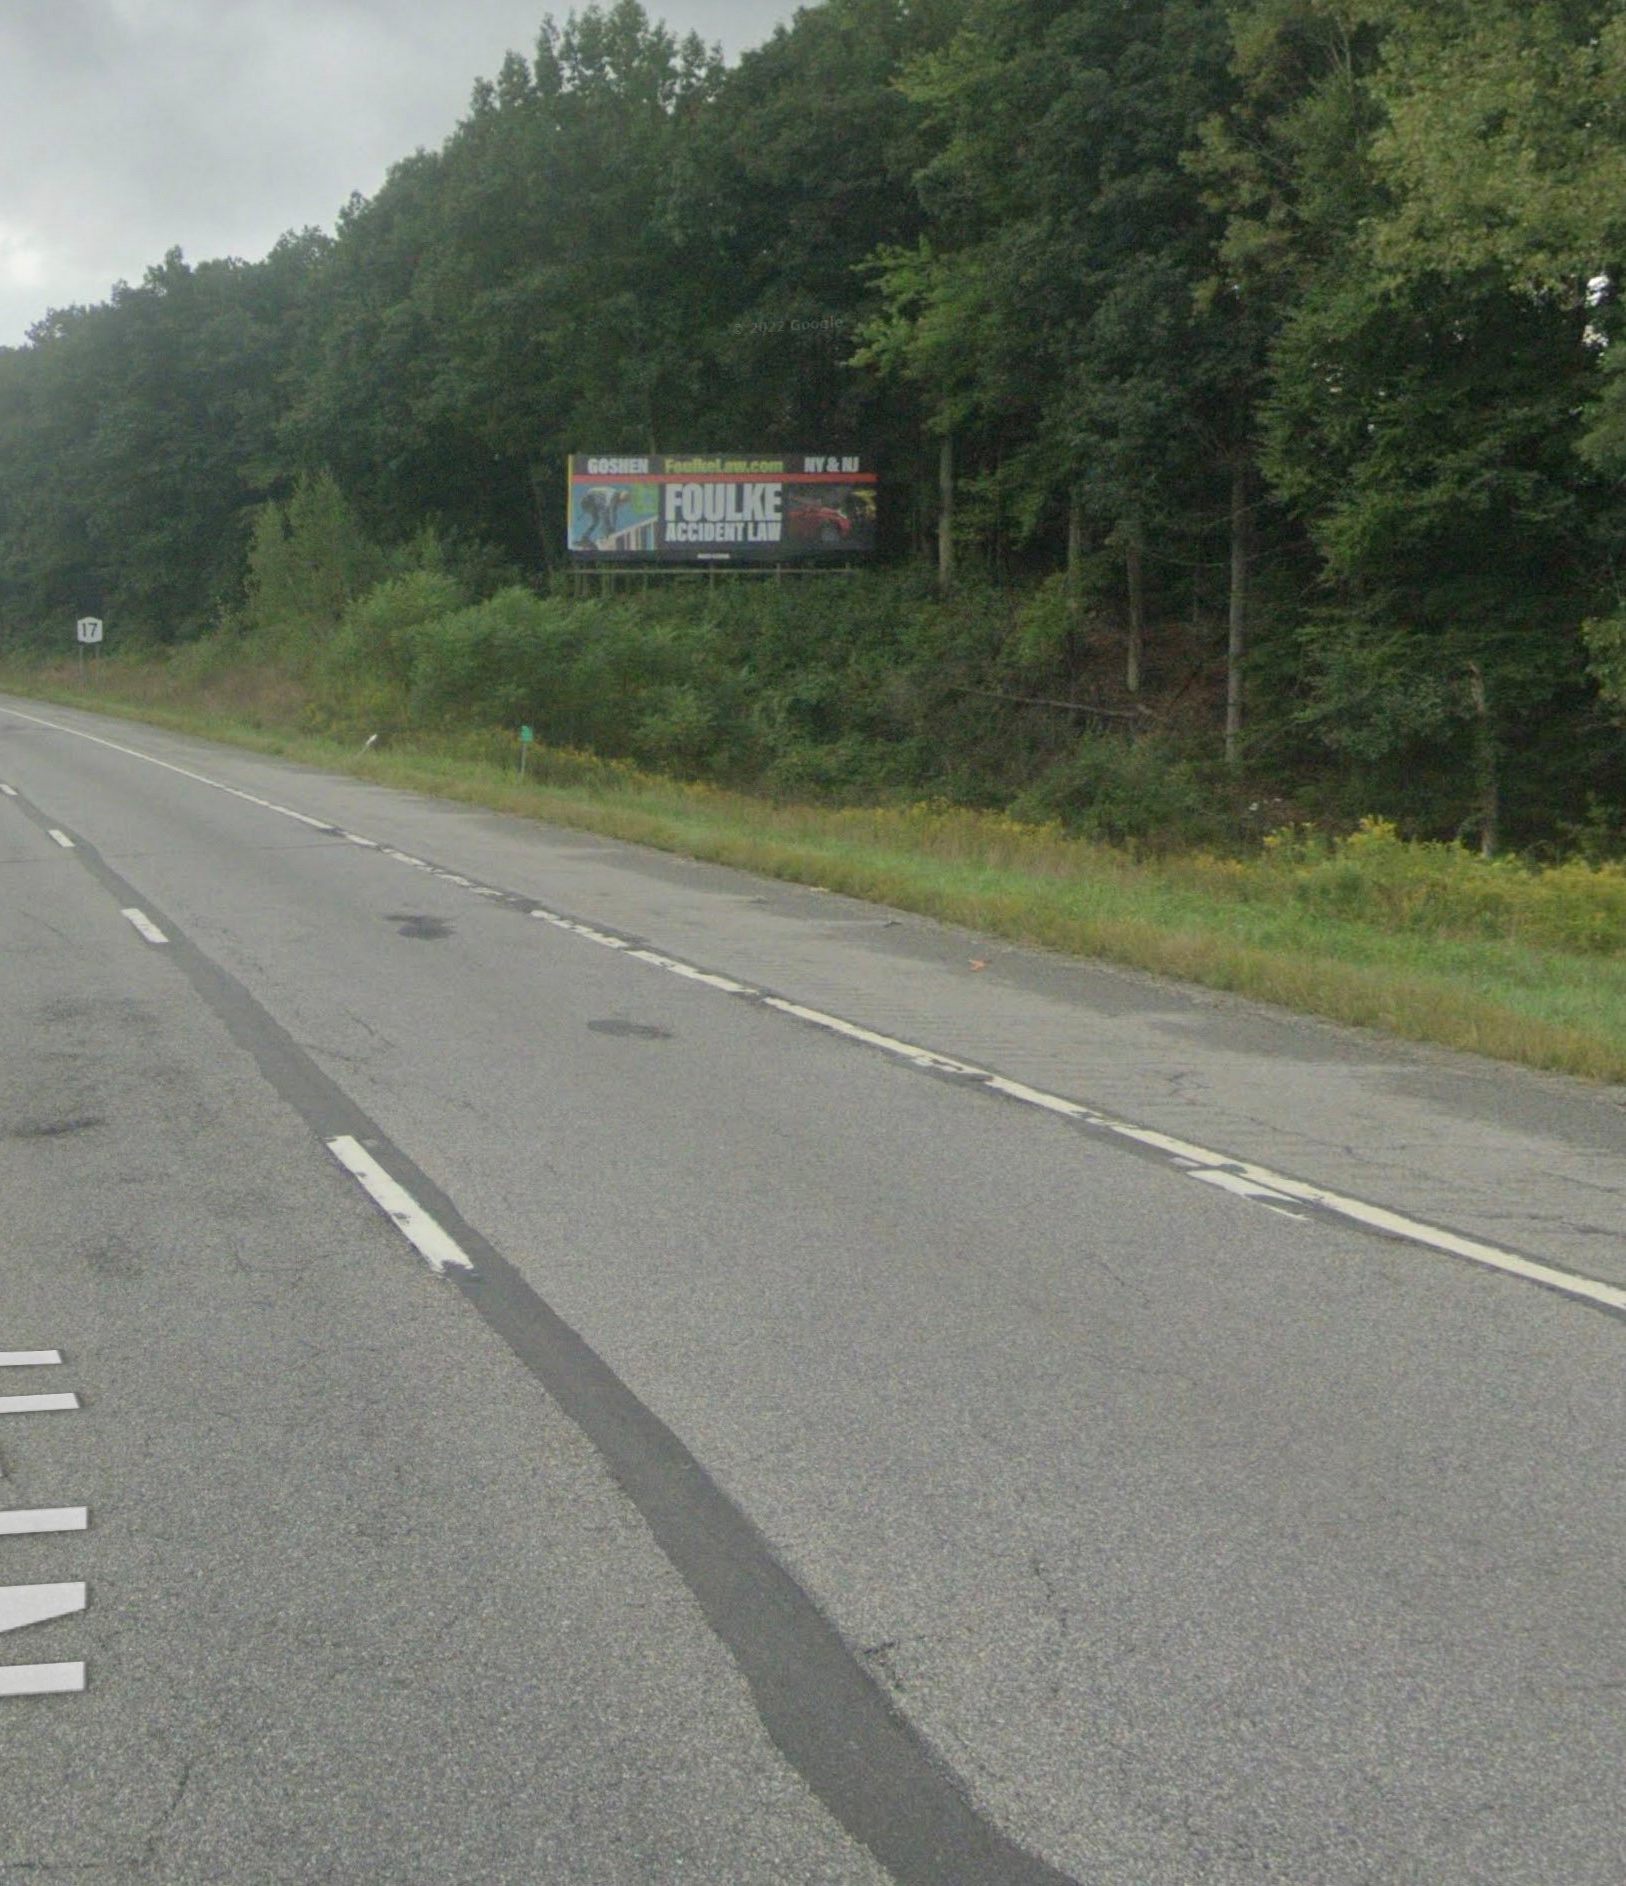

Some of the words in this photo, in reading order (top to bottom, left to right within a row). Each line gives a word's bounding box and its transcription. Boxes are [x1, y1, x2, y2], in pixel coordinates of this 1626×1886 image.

[587, 457, 649, 474] GOSHEN
[664, 457, 784, 474] FoulkeLaw.com
[804, 457, 824, 473] NY
[826, 457, 840, 473] &
[842, 456, 860, 472] NJ
[665, 483, 782, 521] FOULKE
[665, 521, 745, 541] ACCIDENT
[747, 521, 781, 541] LAW
[82, 622, 97, 638] 17
